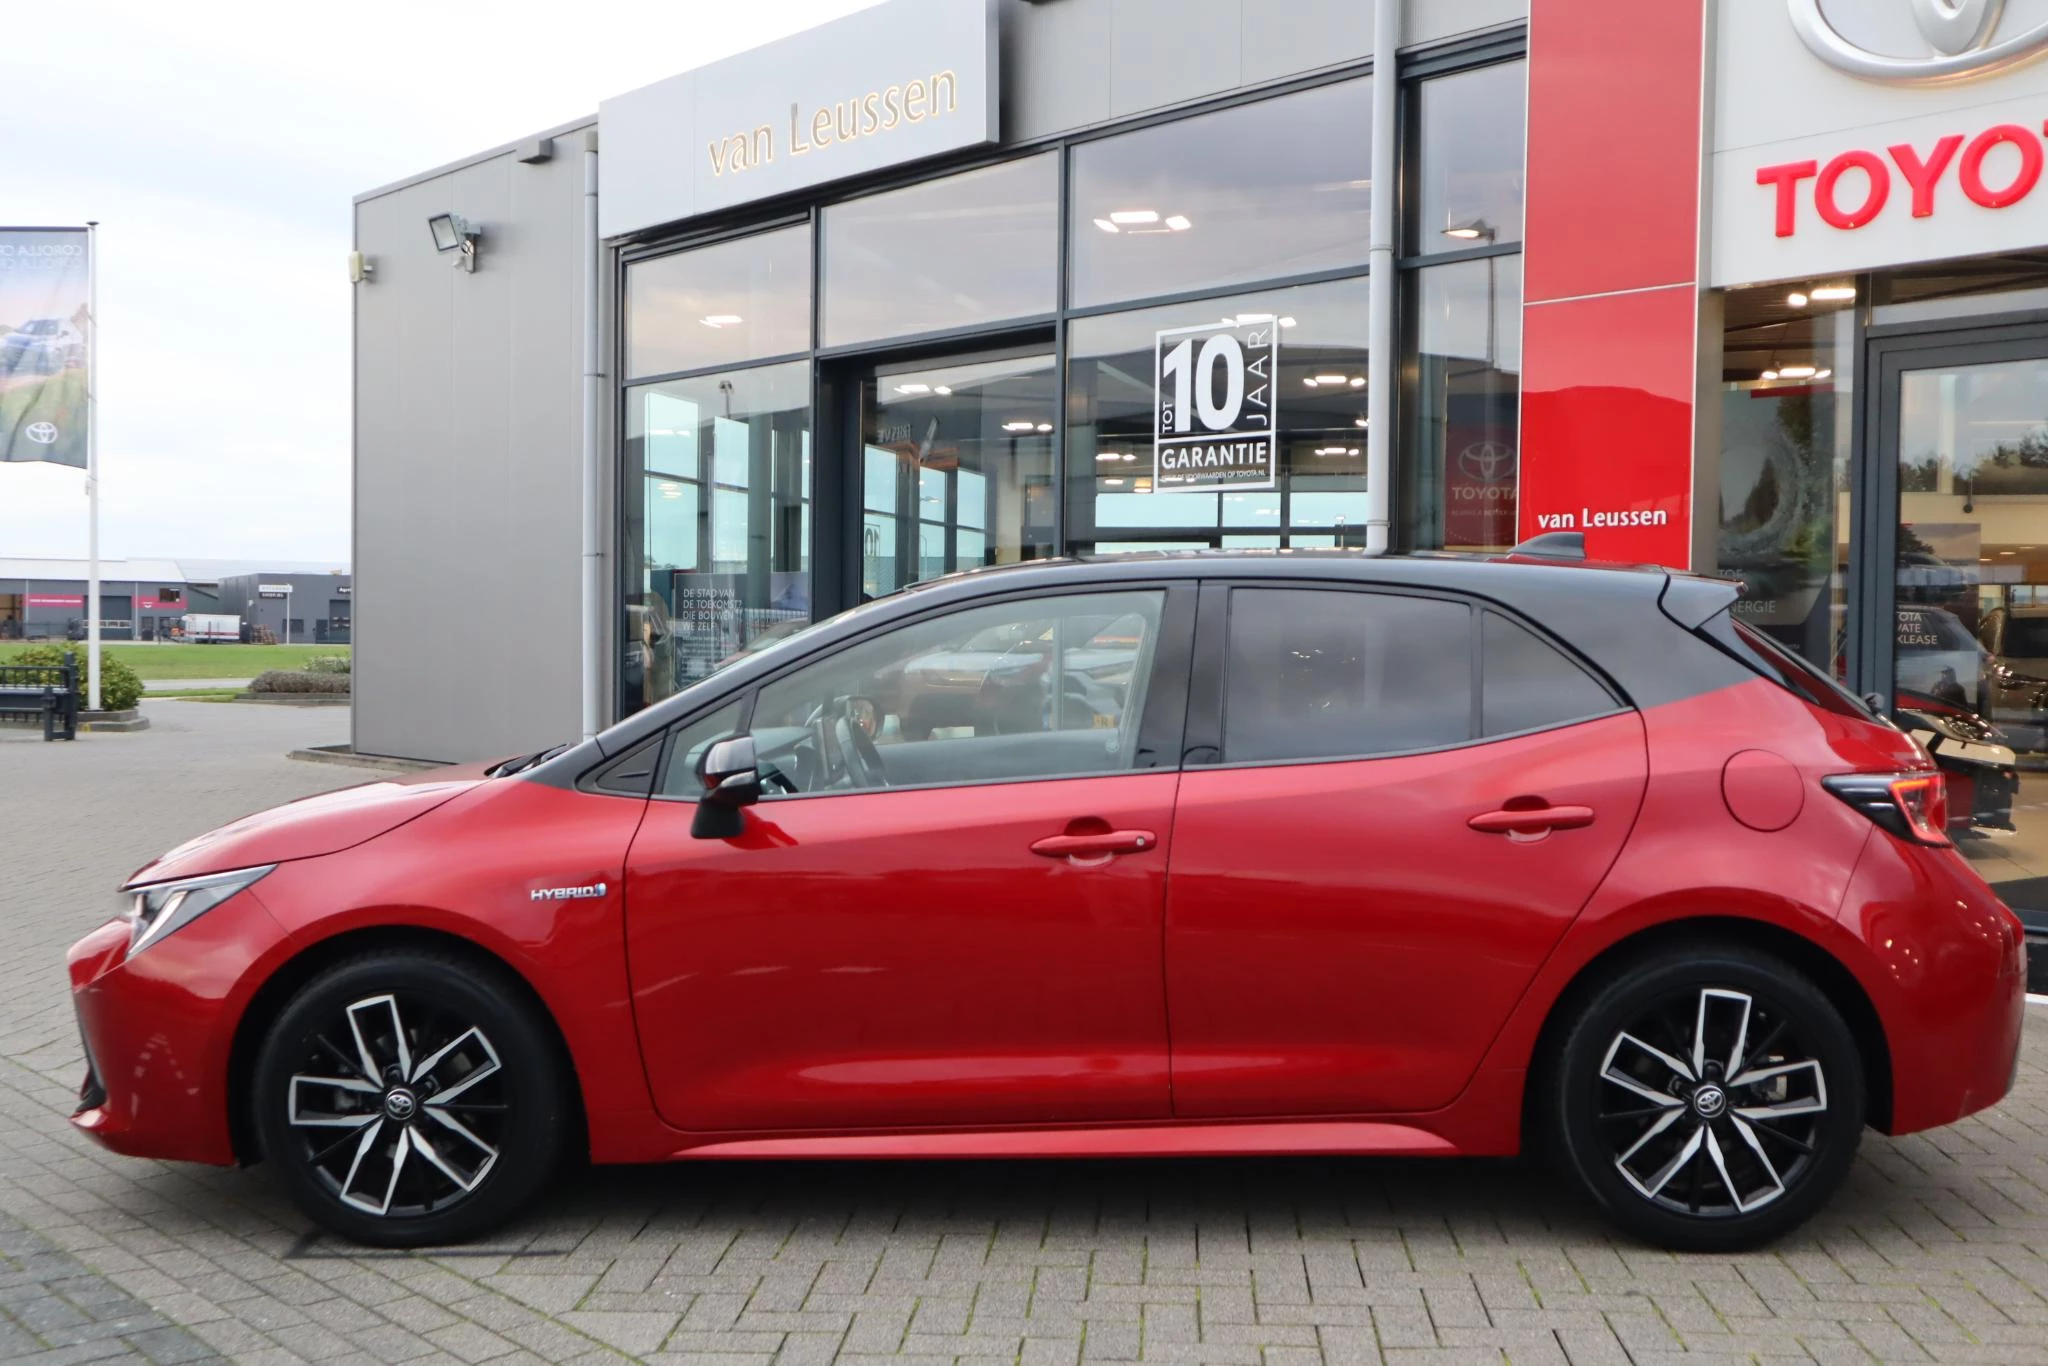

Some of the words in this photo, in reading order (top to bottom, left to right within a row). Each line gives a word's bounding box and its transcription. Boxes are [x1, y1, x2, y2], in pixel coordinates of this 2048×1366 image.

[708, 124, 774, 176] van
[790, 69, 956, 156] Leussen
[1756, 119, 2048, 238] TOYO
[1163, 334, 1245, 433] 10
[1246, 328, 1268, 427] JAAR
[1162, 401, 1173, 434] TOT
[1161, 442, 1267, 469] GARANTIE
[1537, 513, 1575, 529] van
[1582, 507, 1667, 528] Leussen
[683, 588, 695, 598] DE
[697, 588, 717, 598] STAD
[720, 588, 735, 598] VAN
[683, 600, 694, 609] DE
[1730, 601, 1776, 613] NERGIE
[683, 611, 696, 620] DIE
[698, 611, 734, 620] BOUWEN
[1898, 612, 1922, 622] OTA
[683, 622, 696, 631] WE
[531, 886, 594, 900] HYBRID
